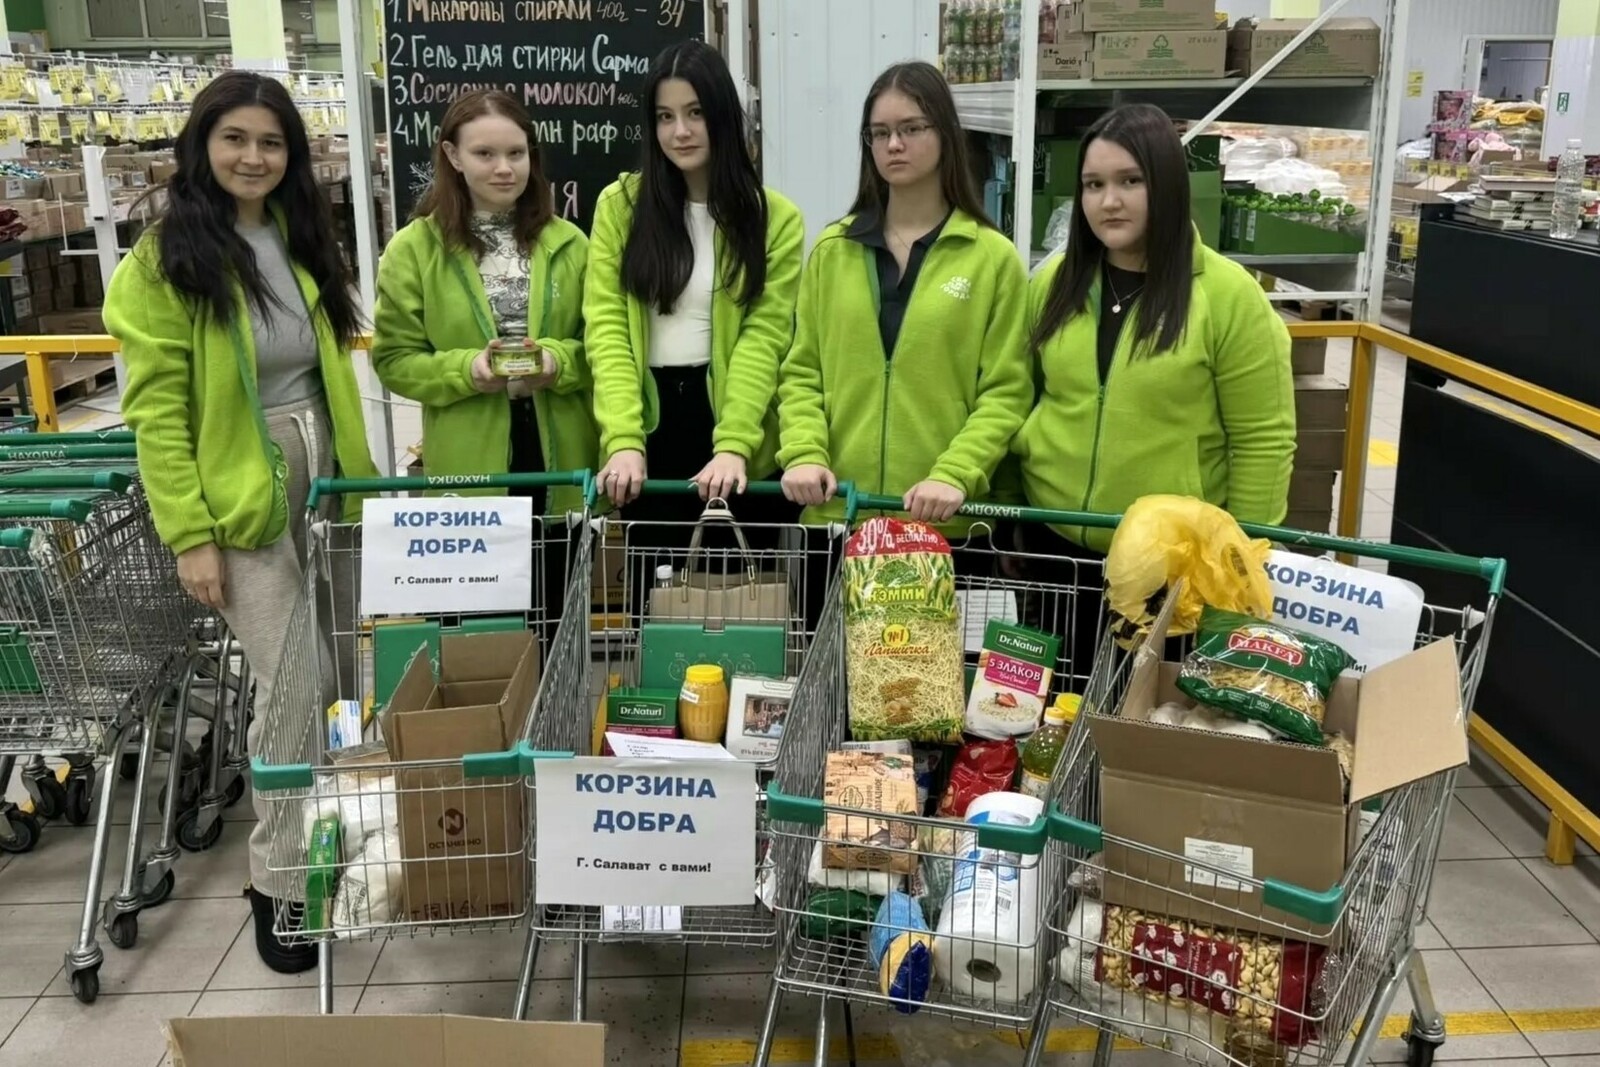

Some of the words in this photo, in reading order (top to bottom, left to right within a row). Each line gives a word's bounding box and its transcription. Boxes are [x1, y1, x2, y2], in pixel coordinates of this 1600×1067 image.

[592, 34, 649, 82] Сарма
[394, 511, 502, 528] КОРЗИНА
[407, 538, 488, 557] ДОБРА
[394, 576, 404, 585] Г.
[408, 575, 453, 585] Салават
[468, 574, 499, 584] вами!
[1263, 562, 1384, 610] КОРЗИНА
[1272, 596, 1360, 636] ДОБРА
[989, 658, 996, 667] 5
[997, 661, 1041, 681] ЗЛАКОВ
[576, 773, 716, 799] КОРЗИНА
[593, 810, 696, 834] ДОБРА
[577, 857, 589, 868] Г.
[593, 858, 651, 871] Салават
[659, 863, 667, 871] с
[672, 862, 712, 873] вами!
